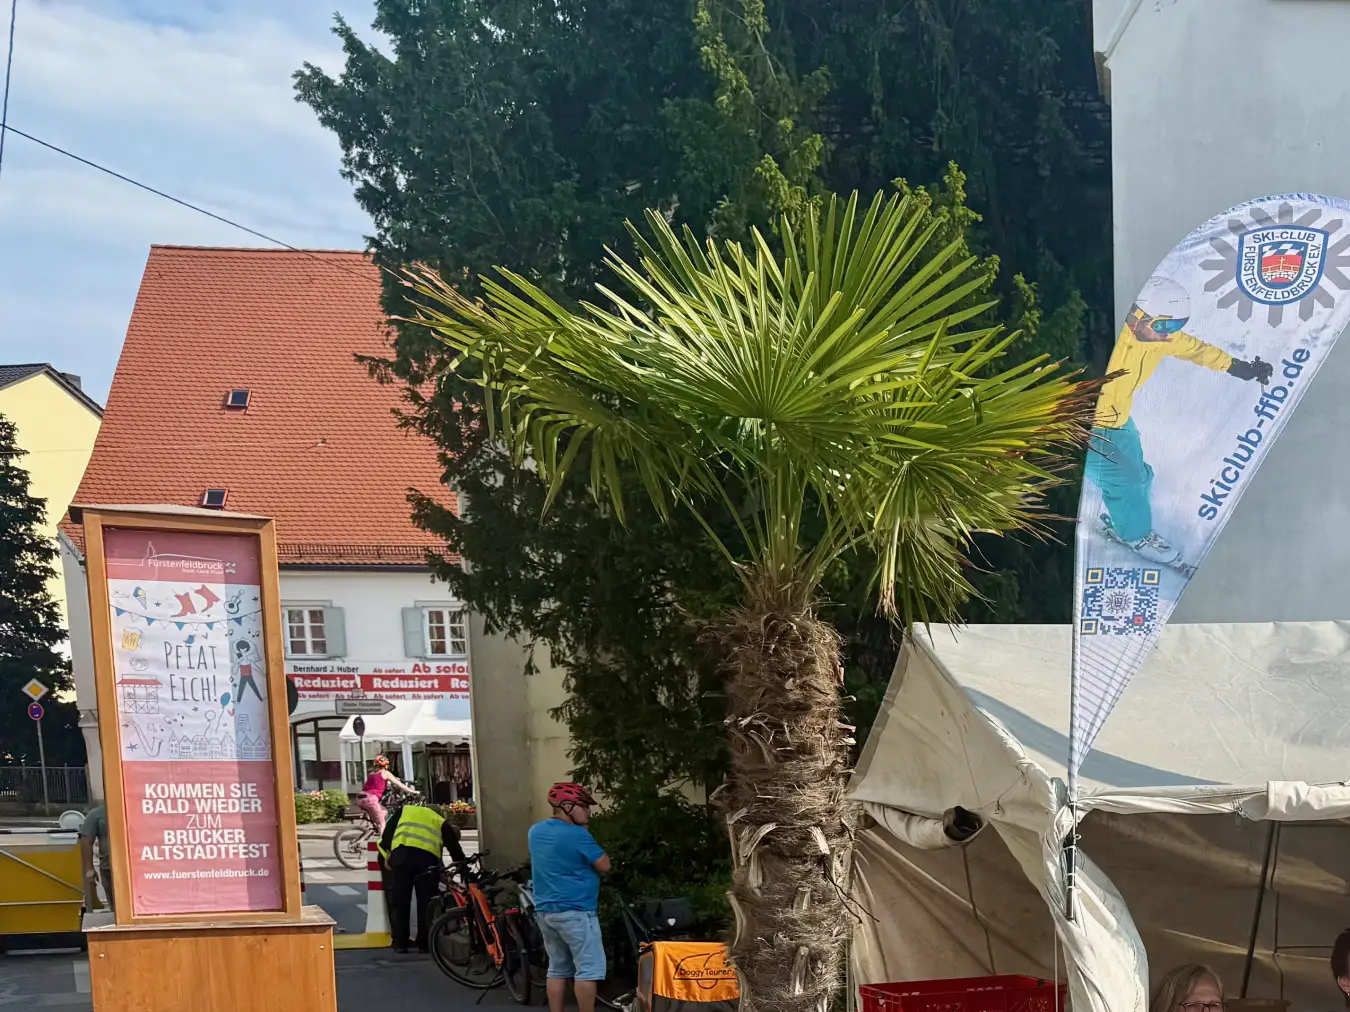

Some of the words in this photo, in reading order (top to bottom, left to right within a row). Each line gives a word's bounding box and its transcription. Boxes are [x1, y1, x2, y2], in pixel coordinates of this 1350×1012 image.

[1252, 230, 1316, 244] SKI-CLUB
[1198, 347, 1311, 521] skiclub-ffb.de
[148, 559, 223, 570] Fürstenfeldbruck
[293, 665, 327, 673] Bernhard
[337, 665, 360, 673] Huber
[412, 663, 432, 673] Ab
[169, 674, 218, 702] EICH!
[294, 676, 361, 689] Reduzier
[373, 677, 439, 689] Reduziert
[144, 783, 224, 798] KOMMEN
[230, 783, 258, 798] SIE
[142, 799, 189, 814] BALD
[194, 798, 263, 814] WIEDER
[186, 814, 222, 829] ZUM
[163, 829, 246, 845] BRUCKER
[141, 844, 269, 860] ALTSTADTFEST
[144, 868, 269, 879] www.fuerstenfeldbruck.de
